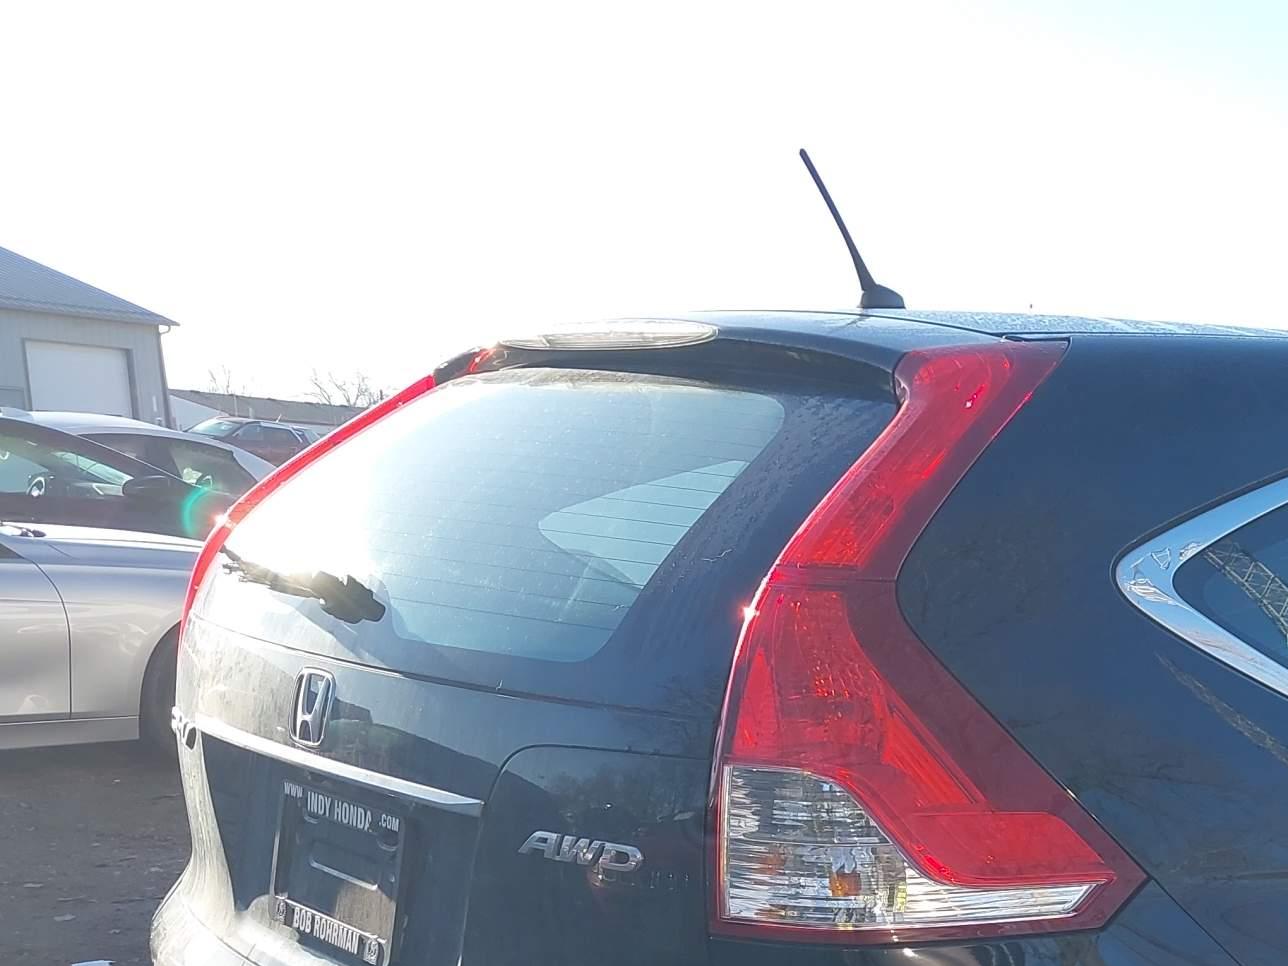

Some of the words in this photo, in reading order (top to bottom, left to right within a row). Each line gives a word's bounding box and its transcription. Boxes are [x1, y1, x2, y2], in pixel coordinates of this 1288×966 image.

[307, 791, 332, 818] INDY
[334, 799, 373, 833] HONDA
[517, 830, 645, 872] AWD
[292, 906, 313, 934] BOB
[313, 914, 361, 955] ROHRMAN
